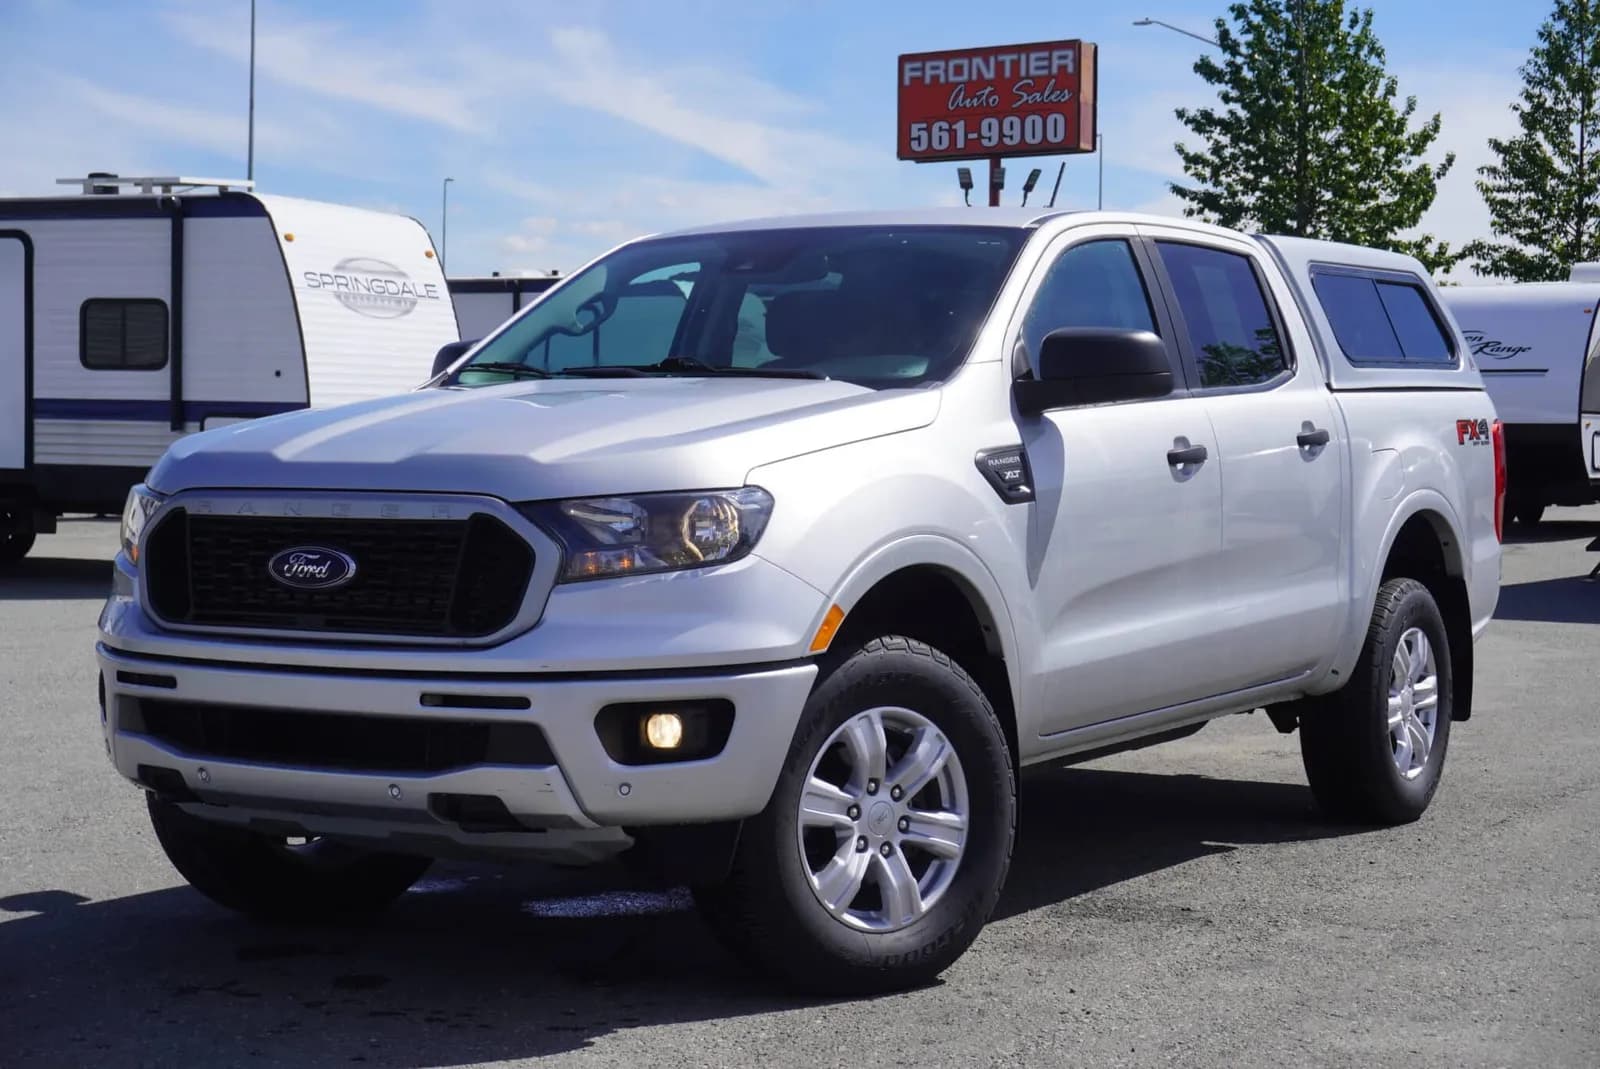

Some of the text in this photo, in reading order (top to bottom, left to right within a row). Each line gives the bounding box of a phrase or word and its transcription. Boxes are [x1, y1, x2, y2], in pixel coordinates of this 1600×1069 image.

[903, 50, 1074, 86] FRONTIER
[948, 79, 1073, 111] Auto Sales
[910, 113, 1066, 152] 561-9900
[303, 271, 440, 299] SPRINGDALE
[1471, 340, 1533, 360] Range
[1456, 418, 1490, 446] FX4
[987, 456, 1020, 466] RANGER
[1004, 470, 1021, 480] XLT
[197, 502, 453, 518] RANGER
[283, 551, 330, 578] Ford
